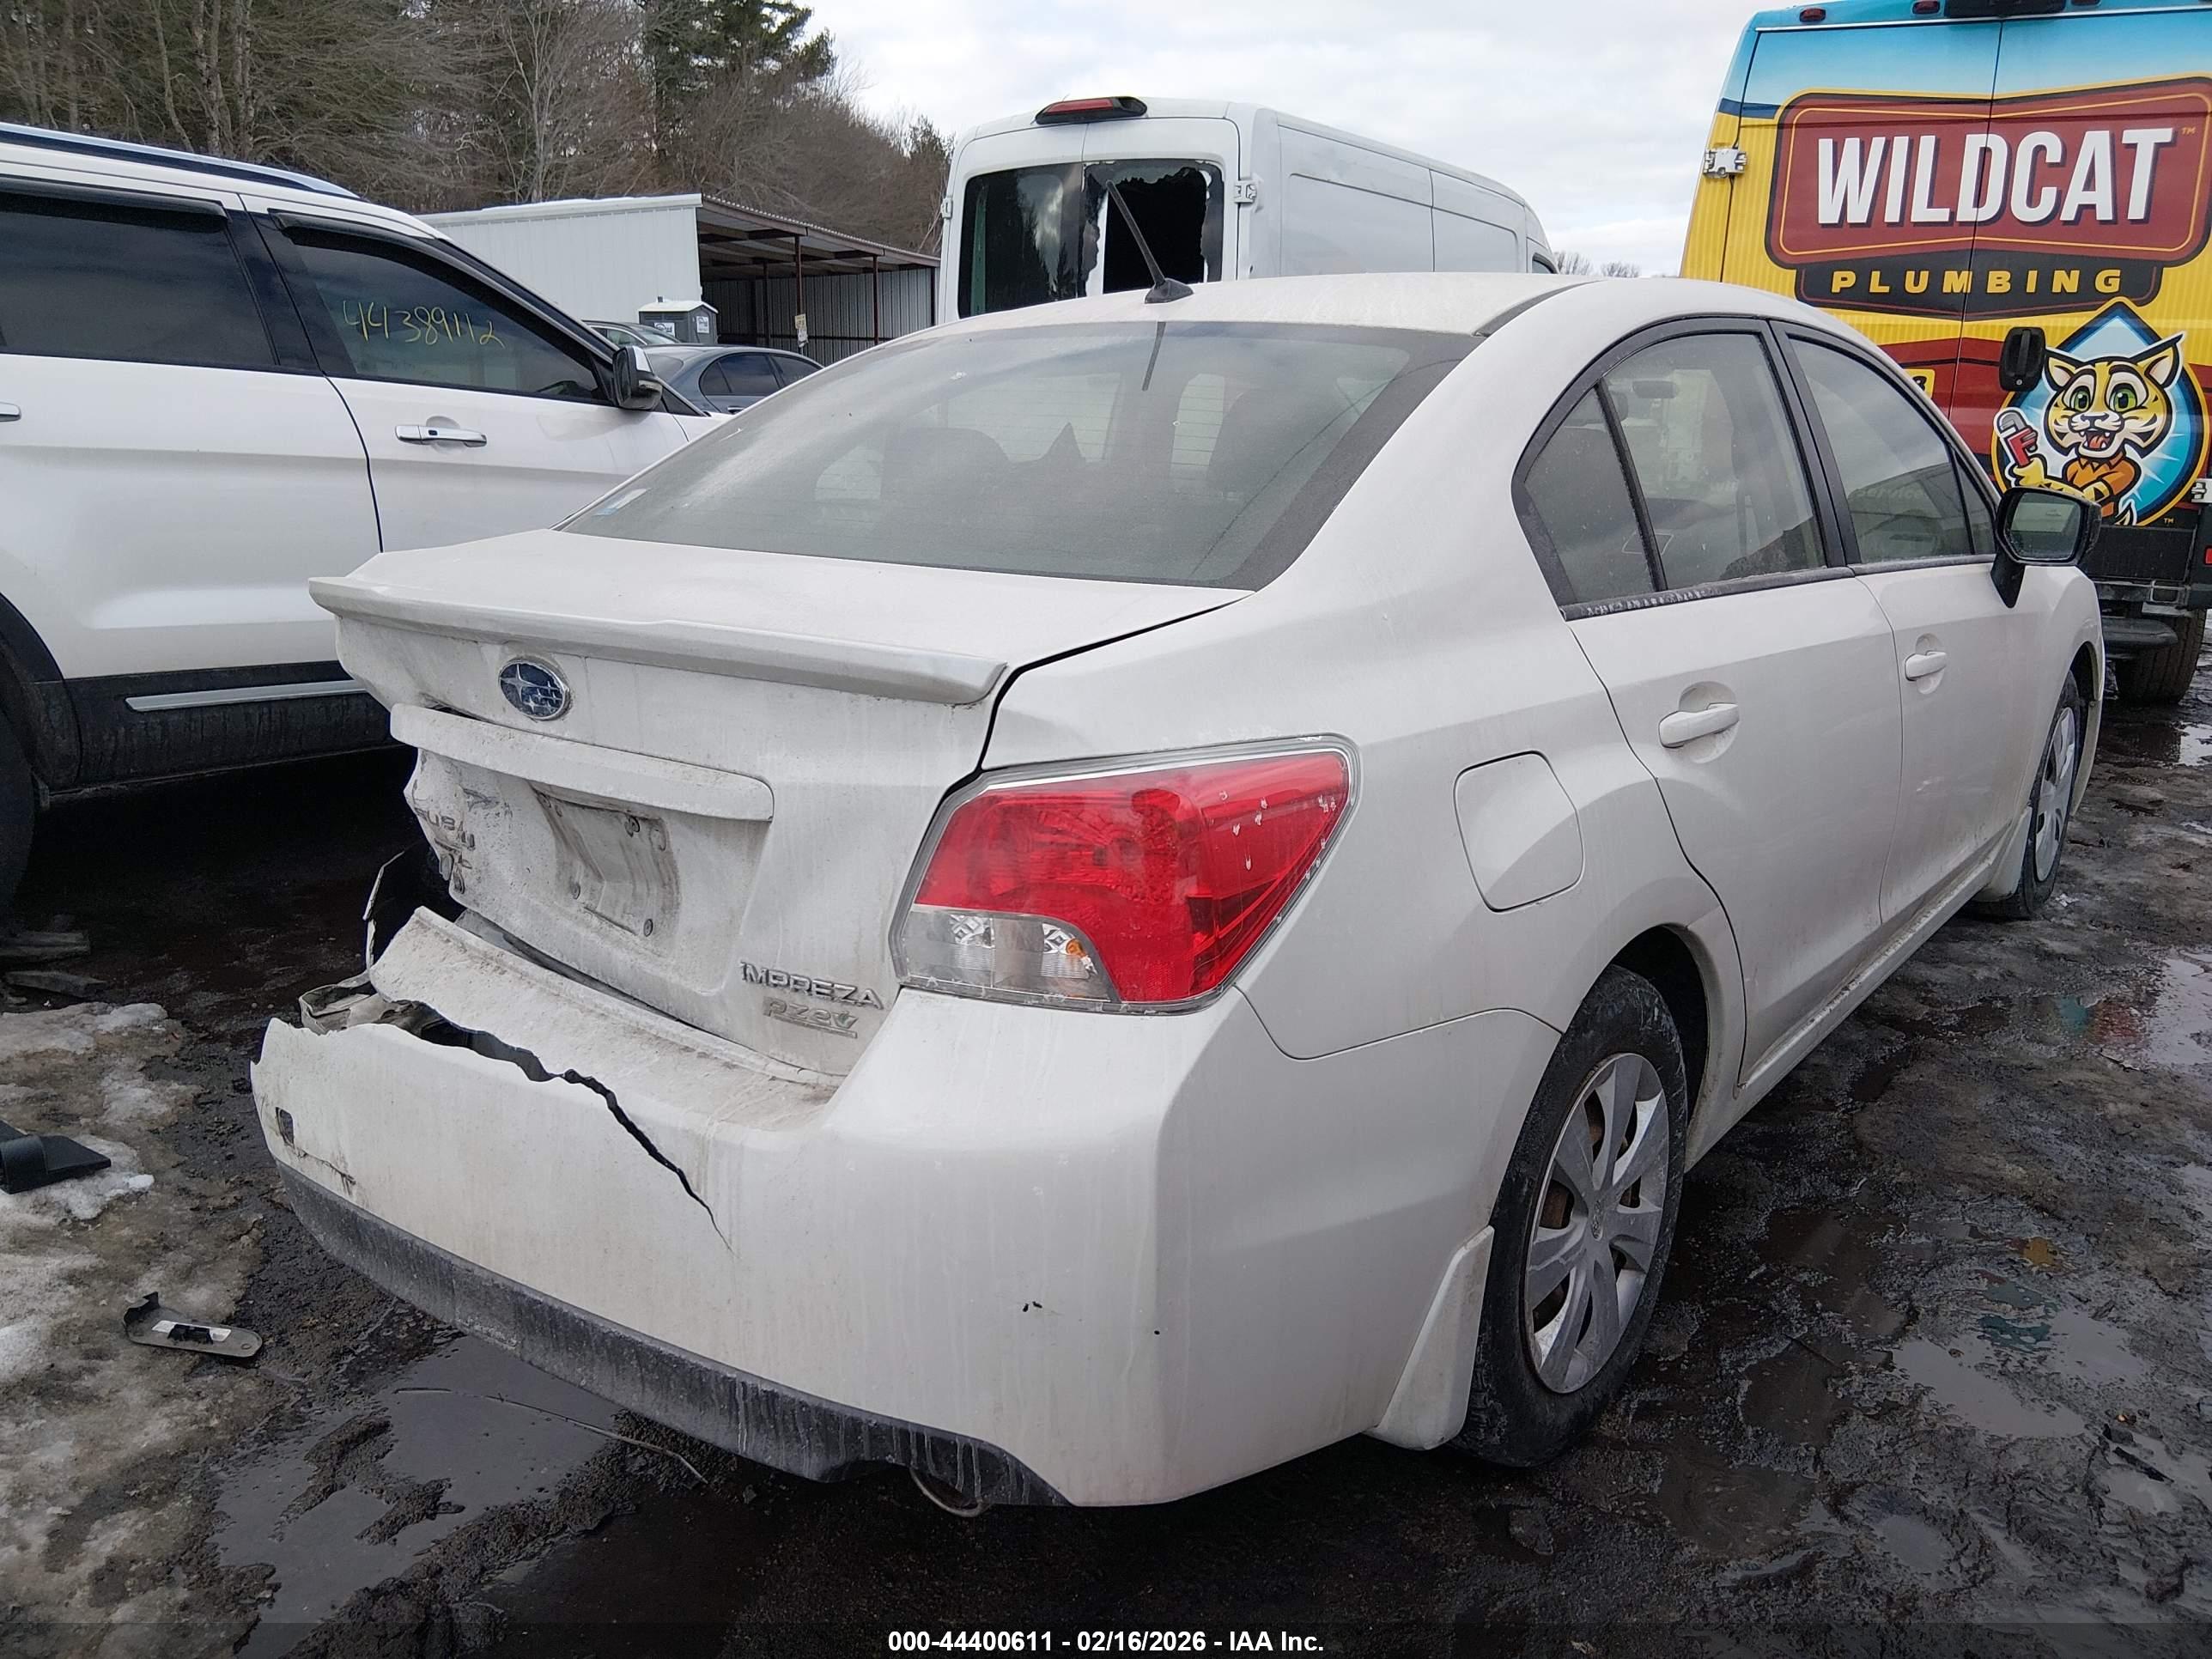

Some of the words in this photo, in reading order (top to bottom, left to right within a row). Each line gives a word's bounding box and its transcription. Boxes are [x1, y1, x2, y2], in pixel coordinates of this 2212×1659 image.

[1818, 127, 2174, 225] WILDCAT
[1831, 268, 2123, 295] PLUMBING
[342, 300, 506, 349] 44389112
